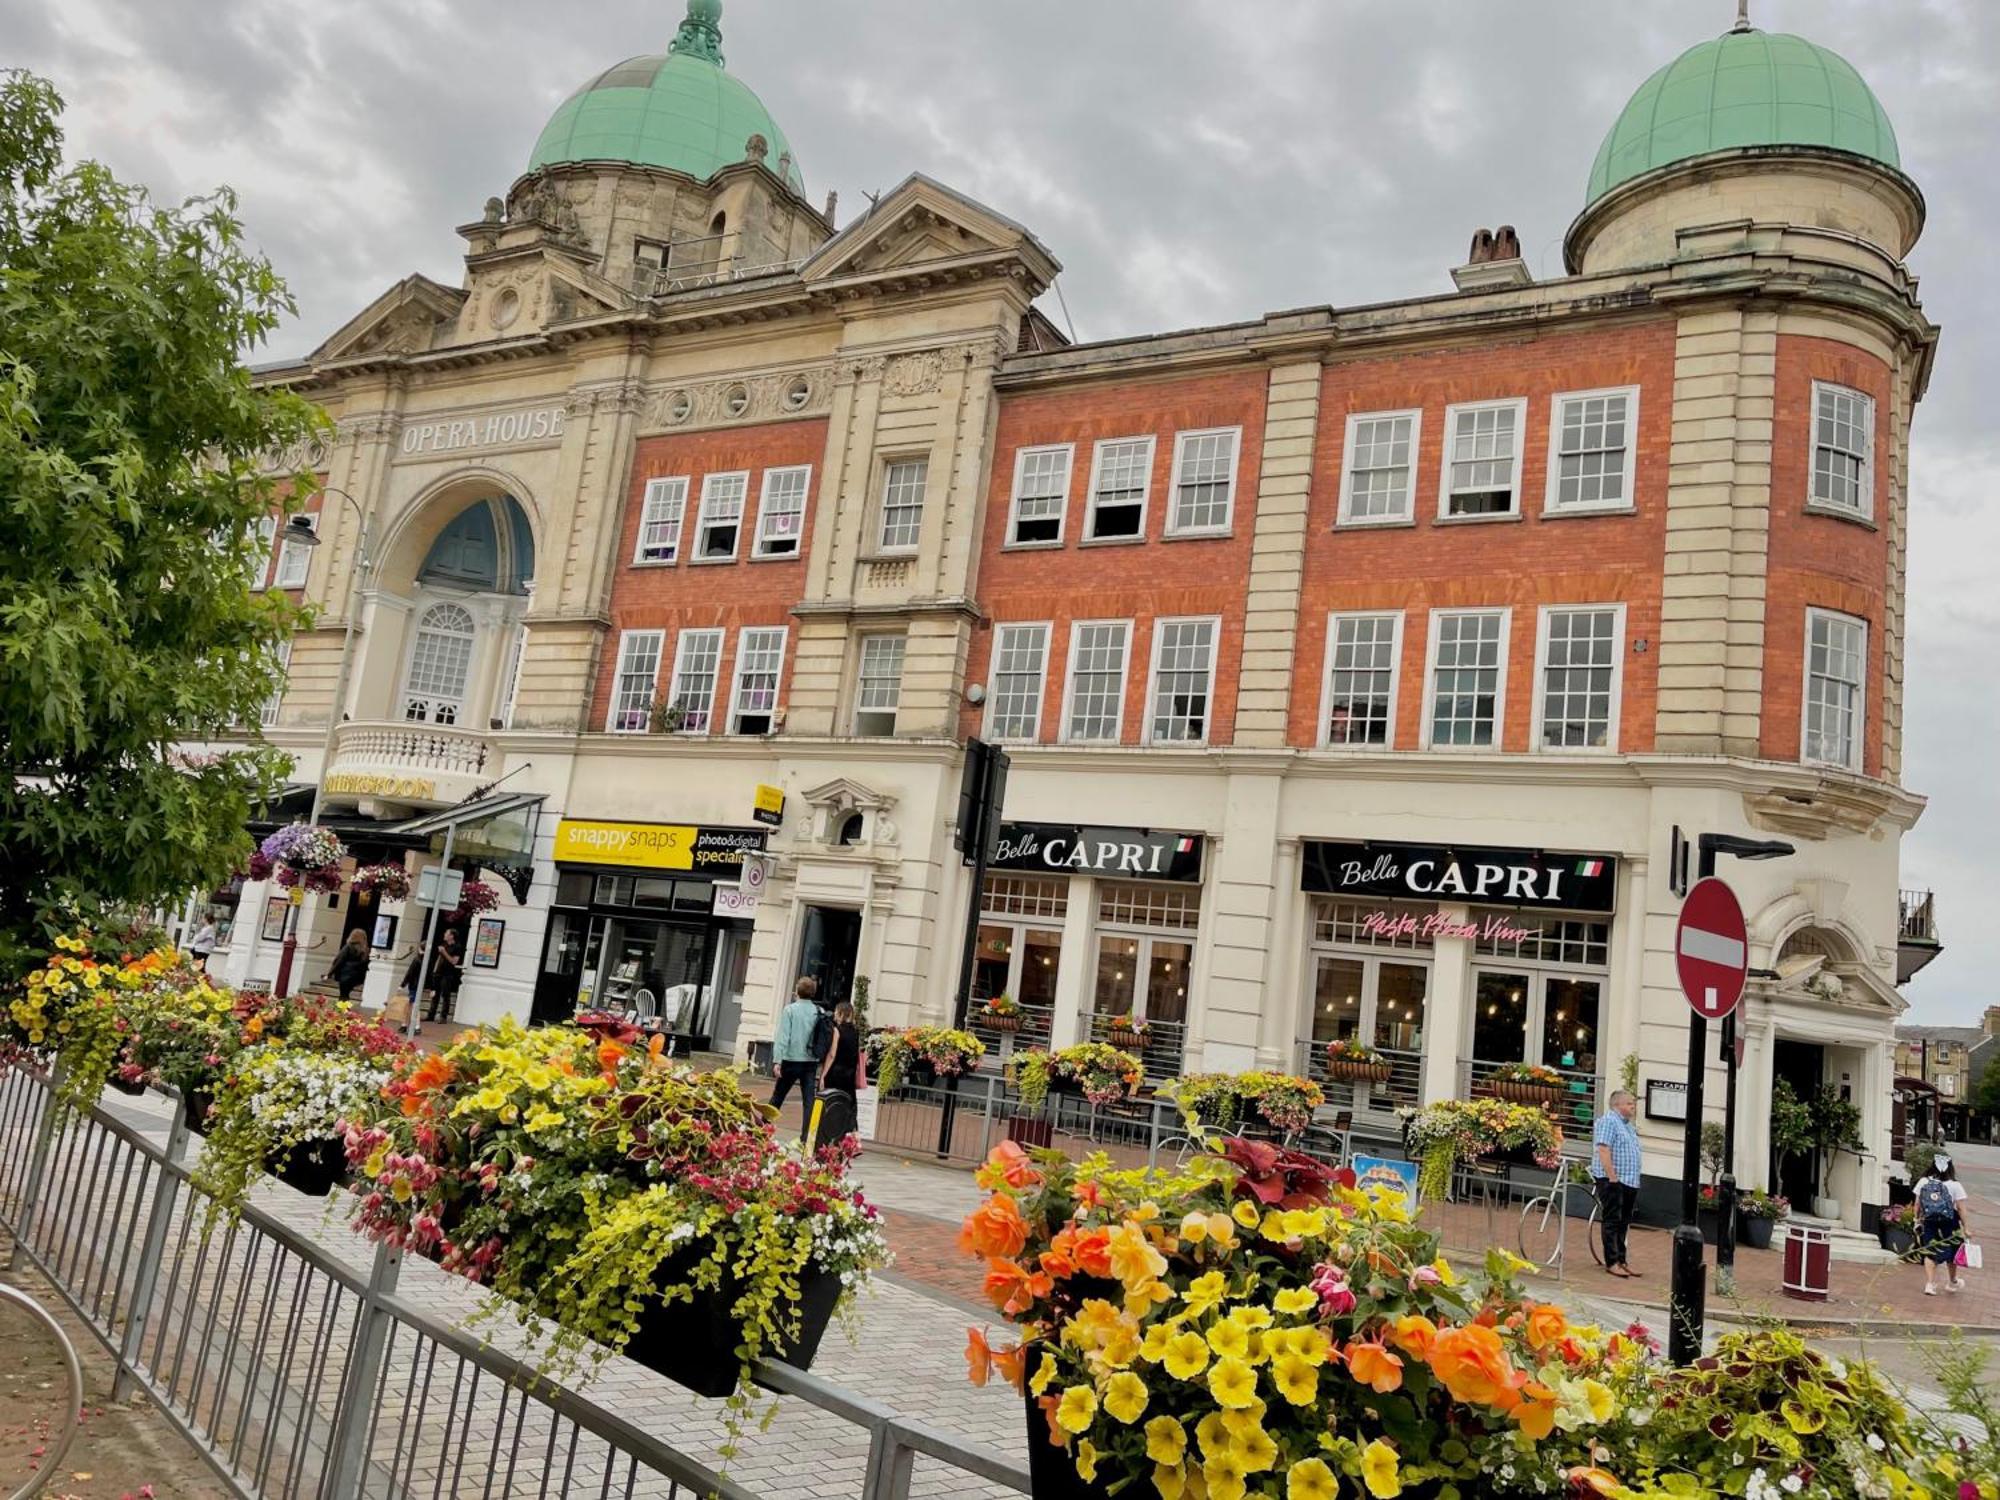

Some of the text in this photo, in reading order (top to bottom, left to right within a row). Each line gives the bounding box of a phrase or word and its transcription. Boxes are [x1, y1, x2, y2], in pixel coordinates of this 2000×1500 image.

[403, 408, 566, 453] OPERA HOUSE
[696, 848, 745, 866] specialis
[698, 834, 761, 850] photo&digital
[995, 833, 1165, 874] Bella CAPRI
[1340, 853, 1566, 901] Bella CAPRI
[1361, 911, 1543, 943] Pasta Pizza Vino
